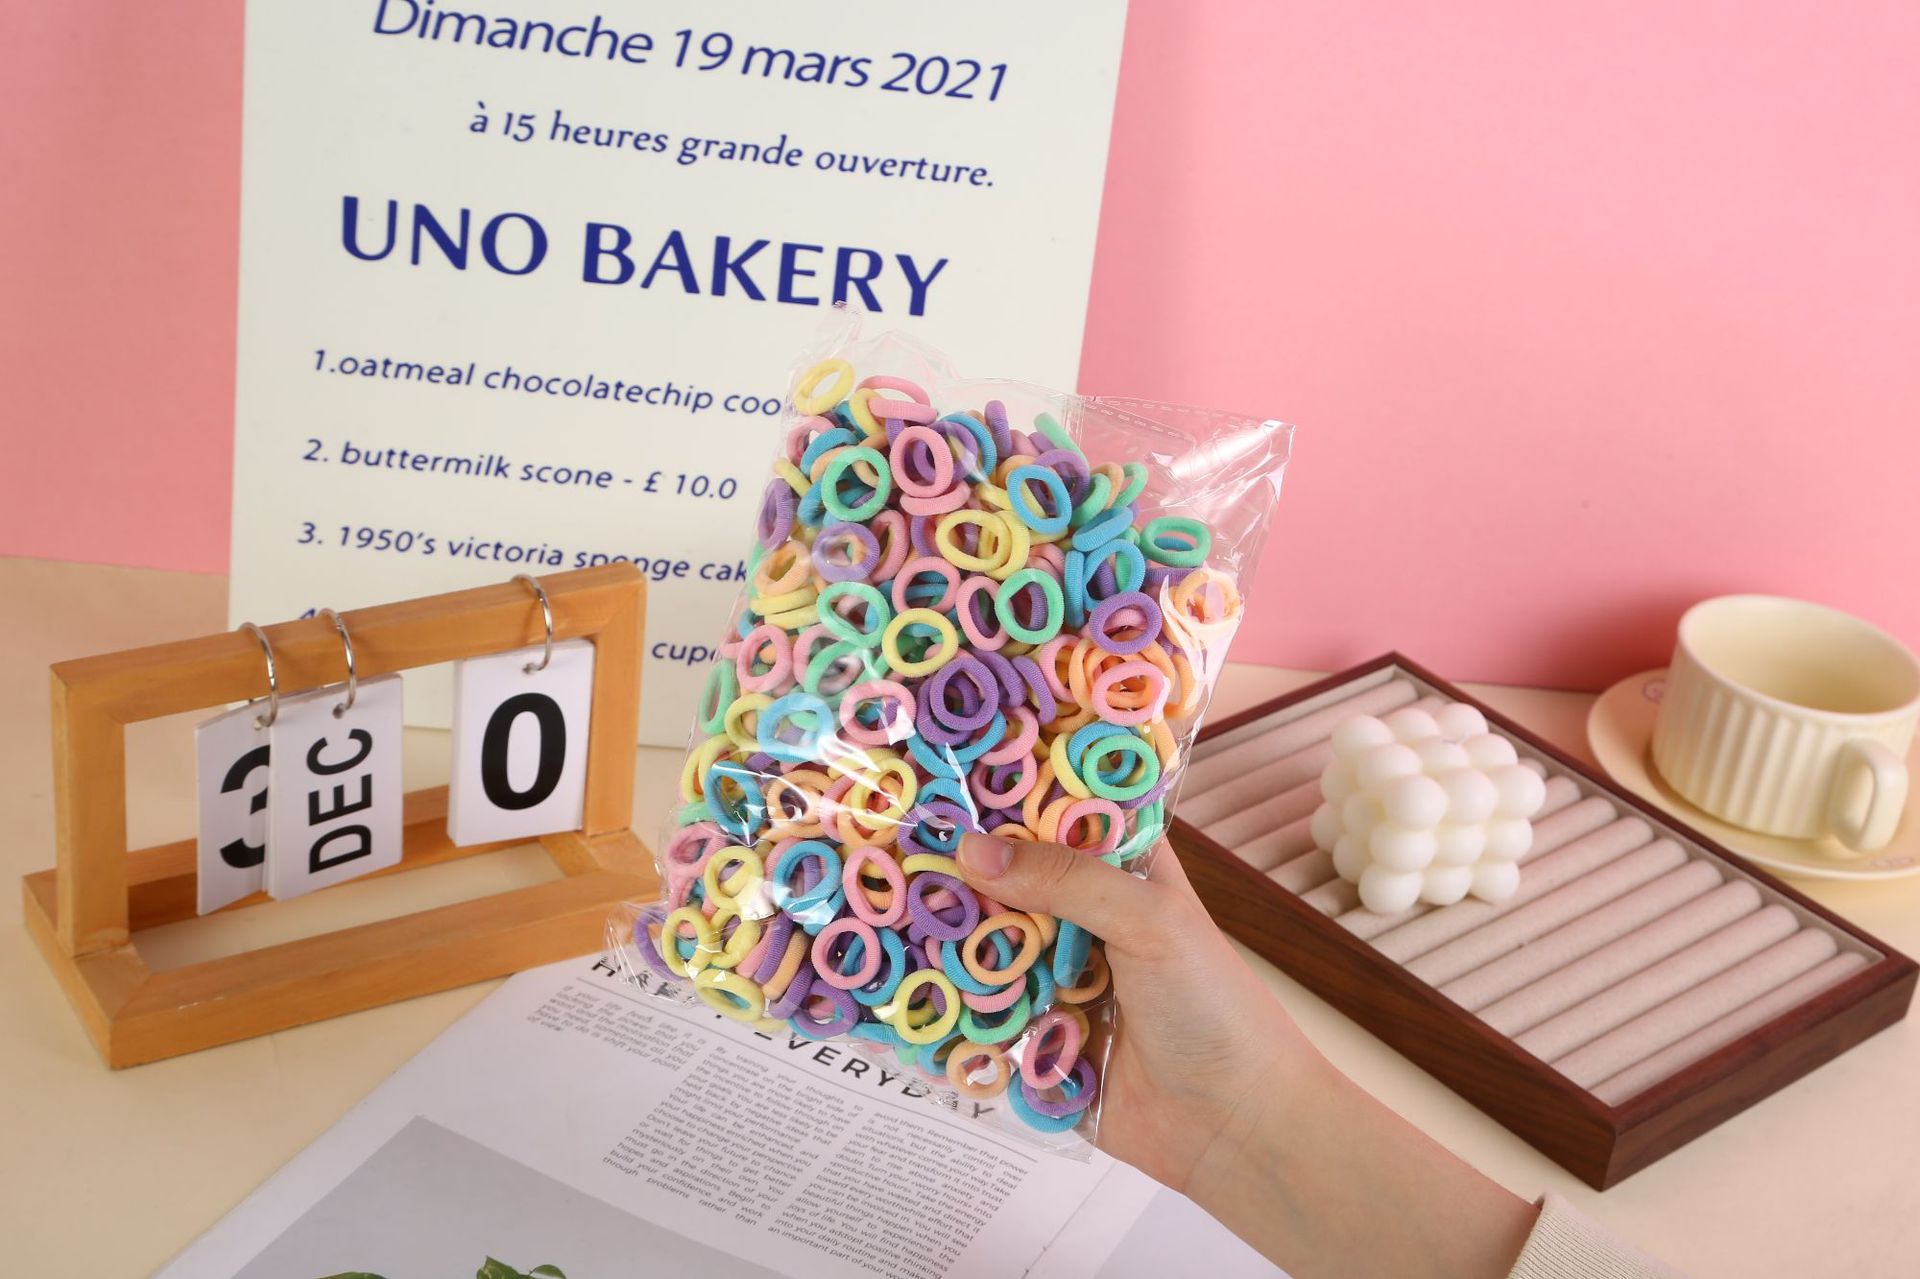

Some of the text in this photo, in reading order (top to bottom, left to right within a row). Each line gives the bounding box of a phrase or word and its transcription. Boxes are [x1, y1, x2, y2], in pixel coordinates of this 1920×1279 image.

[373, 0, 1007, 101] Dimanche 19 mars 2021
[469, 101, 993, 186] à 15 heures grande ouverture.
[342, 195, 949, 317] UNO BAKERY
[314, 348, 476, 385] 1.oatmeal
[484, 367, 713, 413] chocolatechip
[303, 439, 328, 463] 2.
[340, 440, 511, 478] buttermilk
[521, 465, 613, 488] scone
[643, 471, 662, 493] £
[677, 474, 737, 499] 10.0
[297, 521, 323, 545] 3.
[339, 526, 435, 555] 1950's
[448, 542, 563, 565] victoria
[482, 693, 565, 810] 0
[307, 729, 372, 873] DEC
